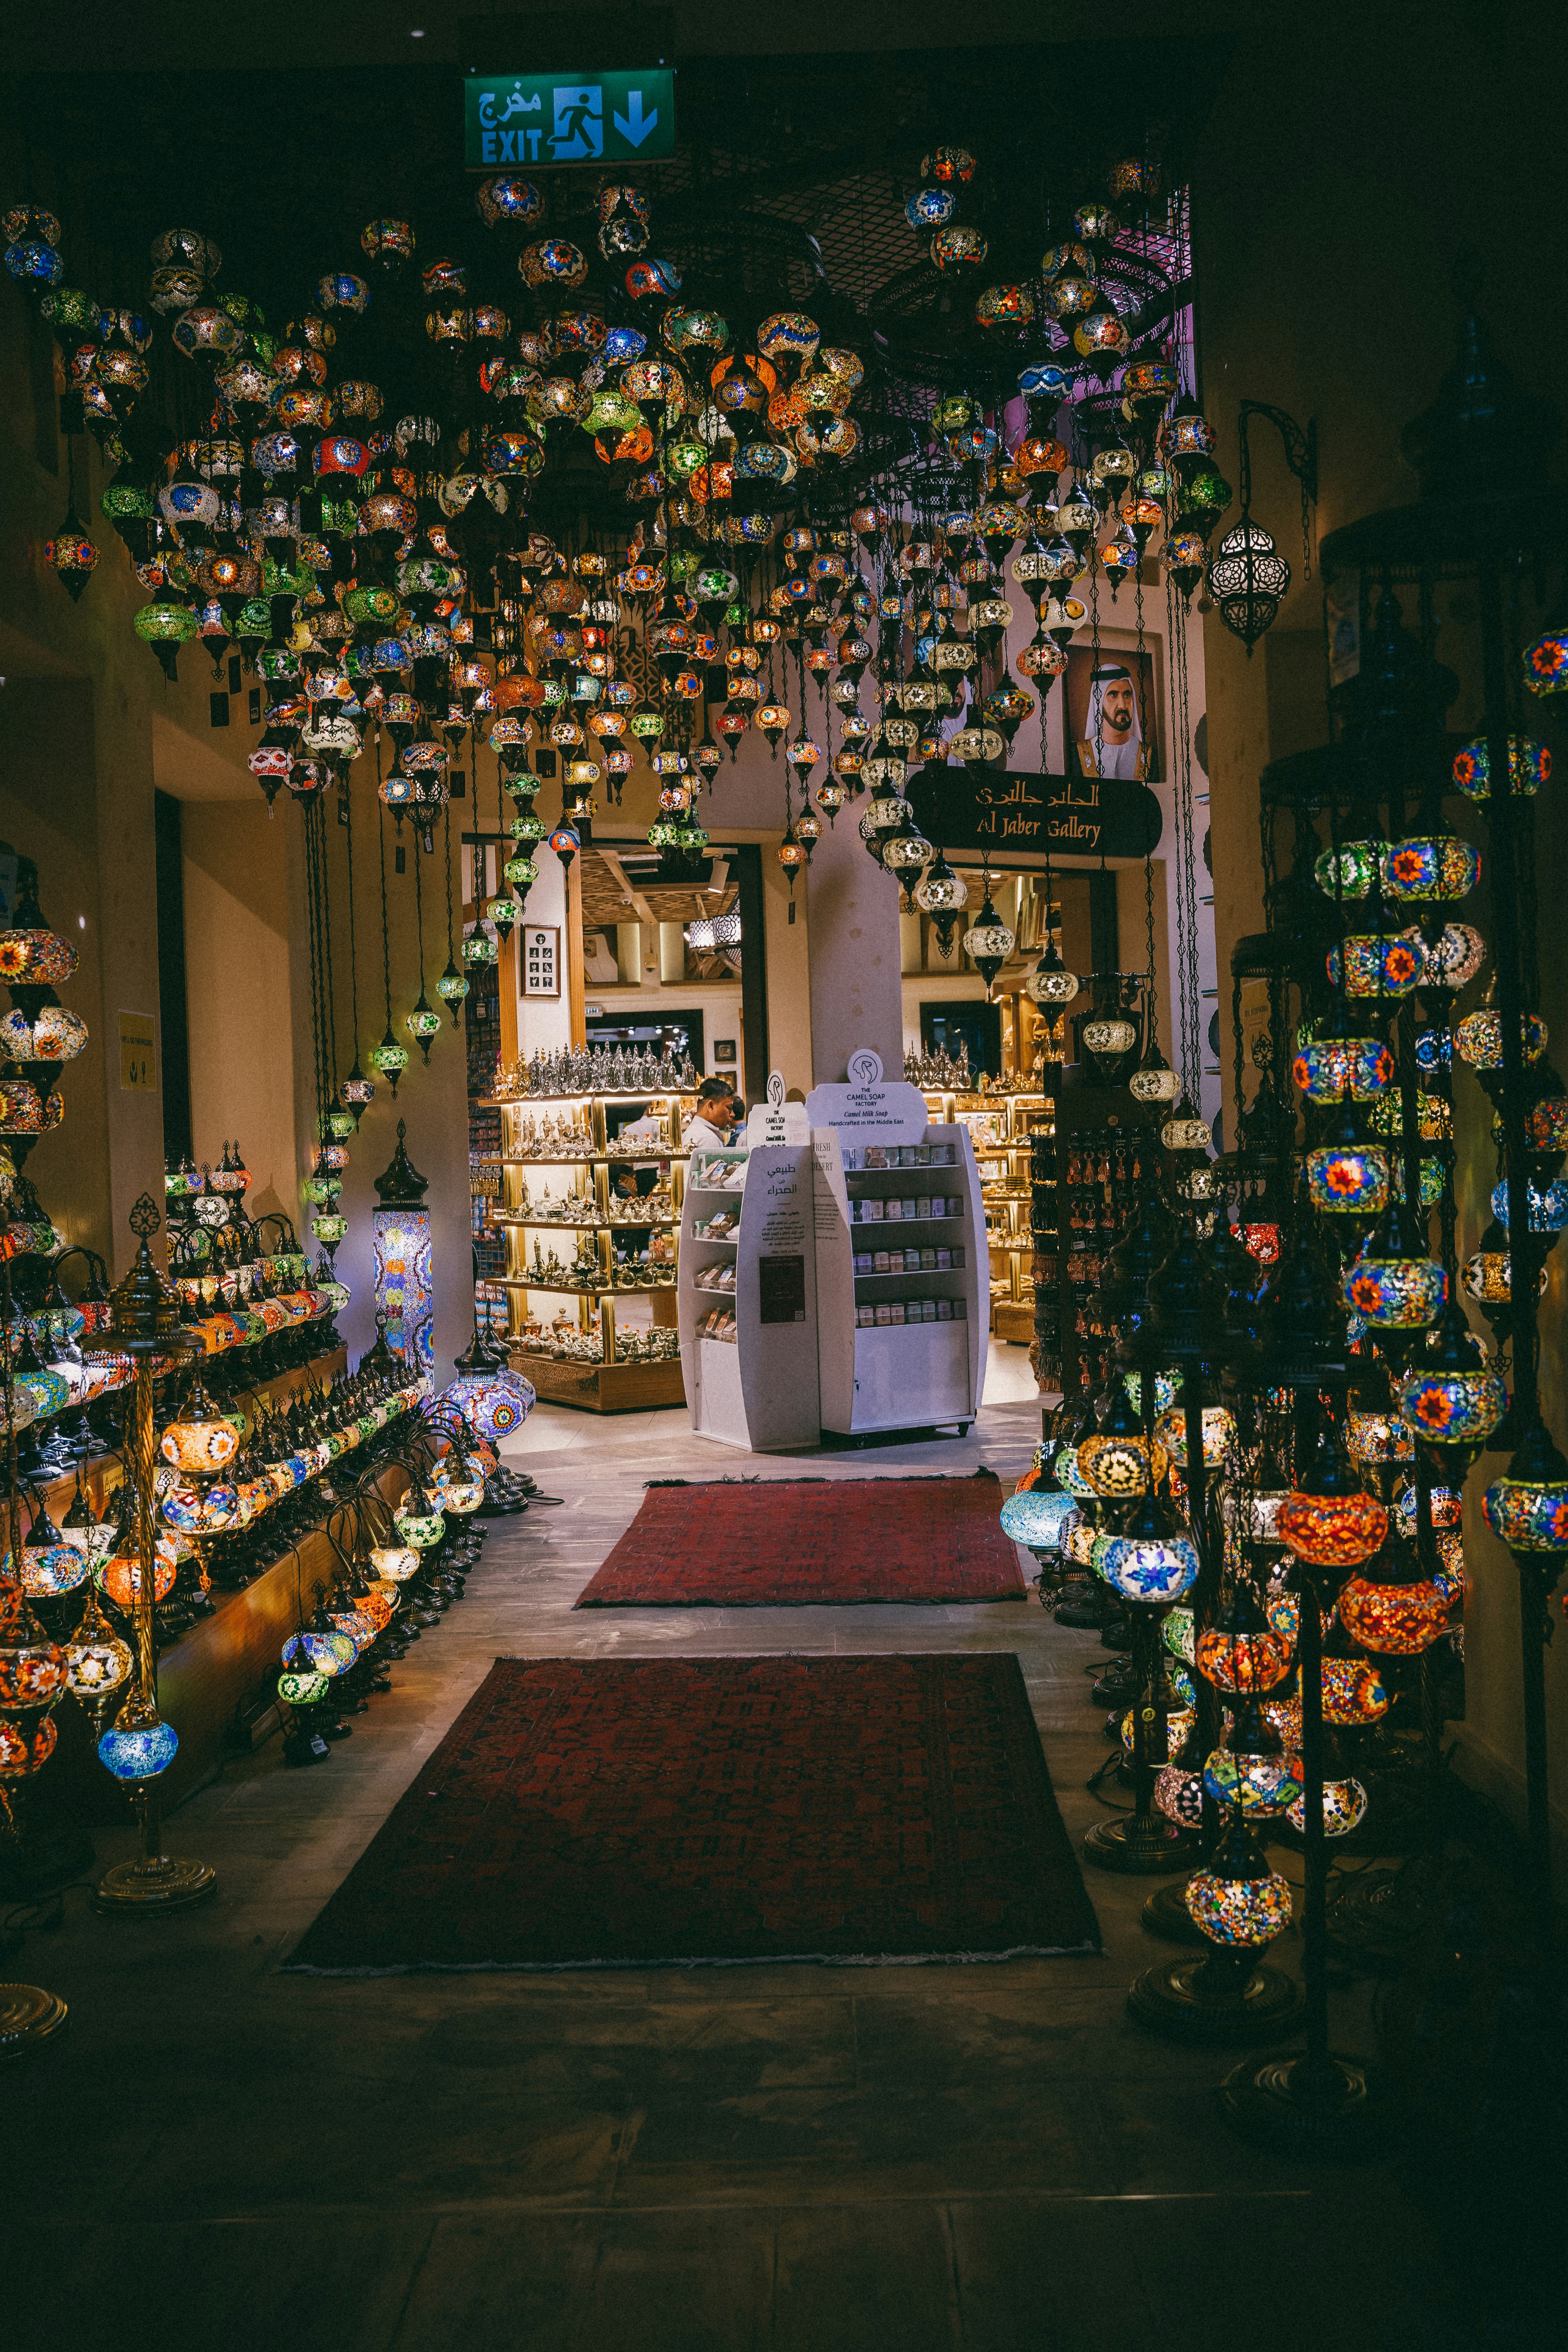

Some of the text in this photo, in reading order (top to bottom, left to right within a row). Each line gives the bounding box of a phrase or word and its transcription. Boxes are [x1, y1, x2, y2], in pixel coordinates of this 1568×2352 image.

[479, 81, 541, 129] مخرج
[482, 129, 542, 163] EXIT
[1047, 784, 1100, 809] الجابر
[977, 811, 1101, 847] Al Jaber Gallery
[812, 1143, 830, 1151] FRESH
[768, 1163, 795, 1178] طبيعي
[812, 1162, 833, 1171] DESERT
[768, 1184, 797, 1196] الصحراء
